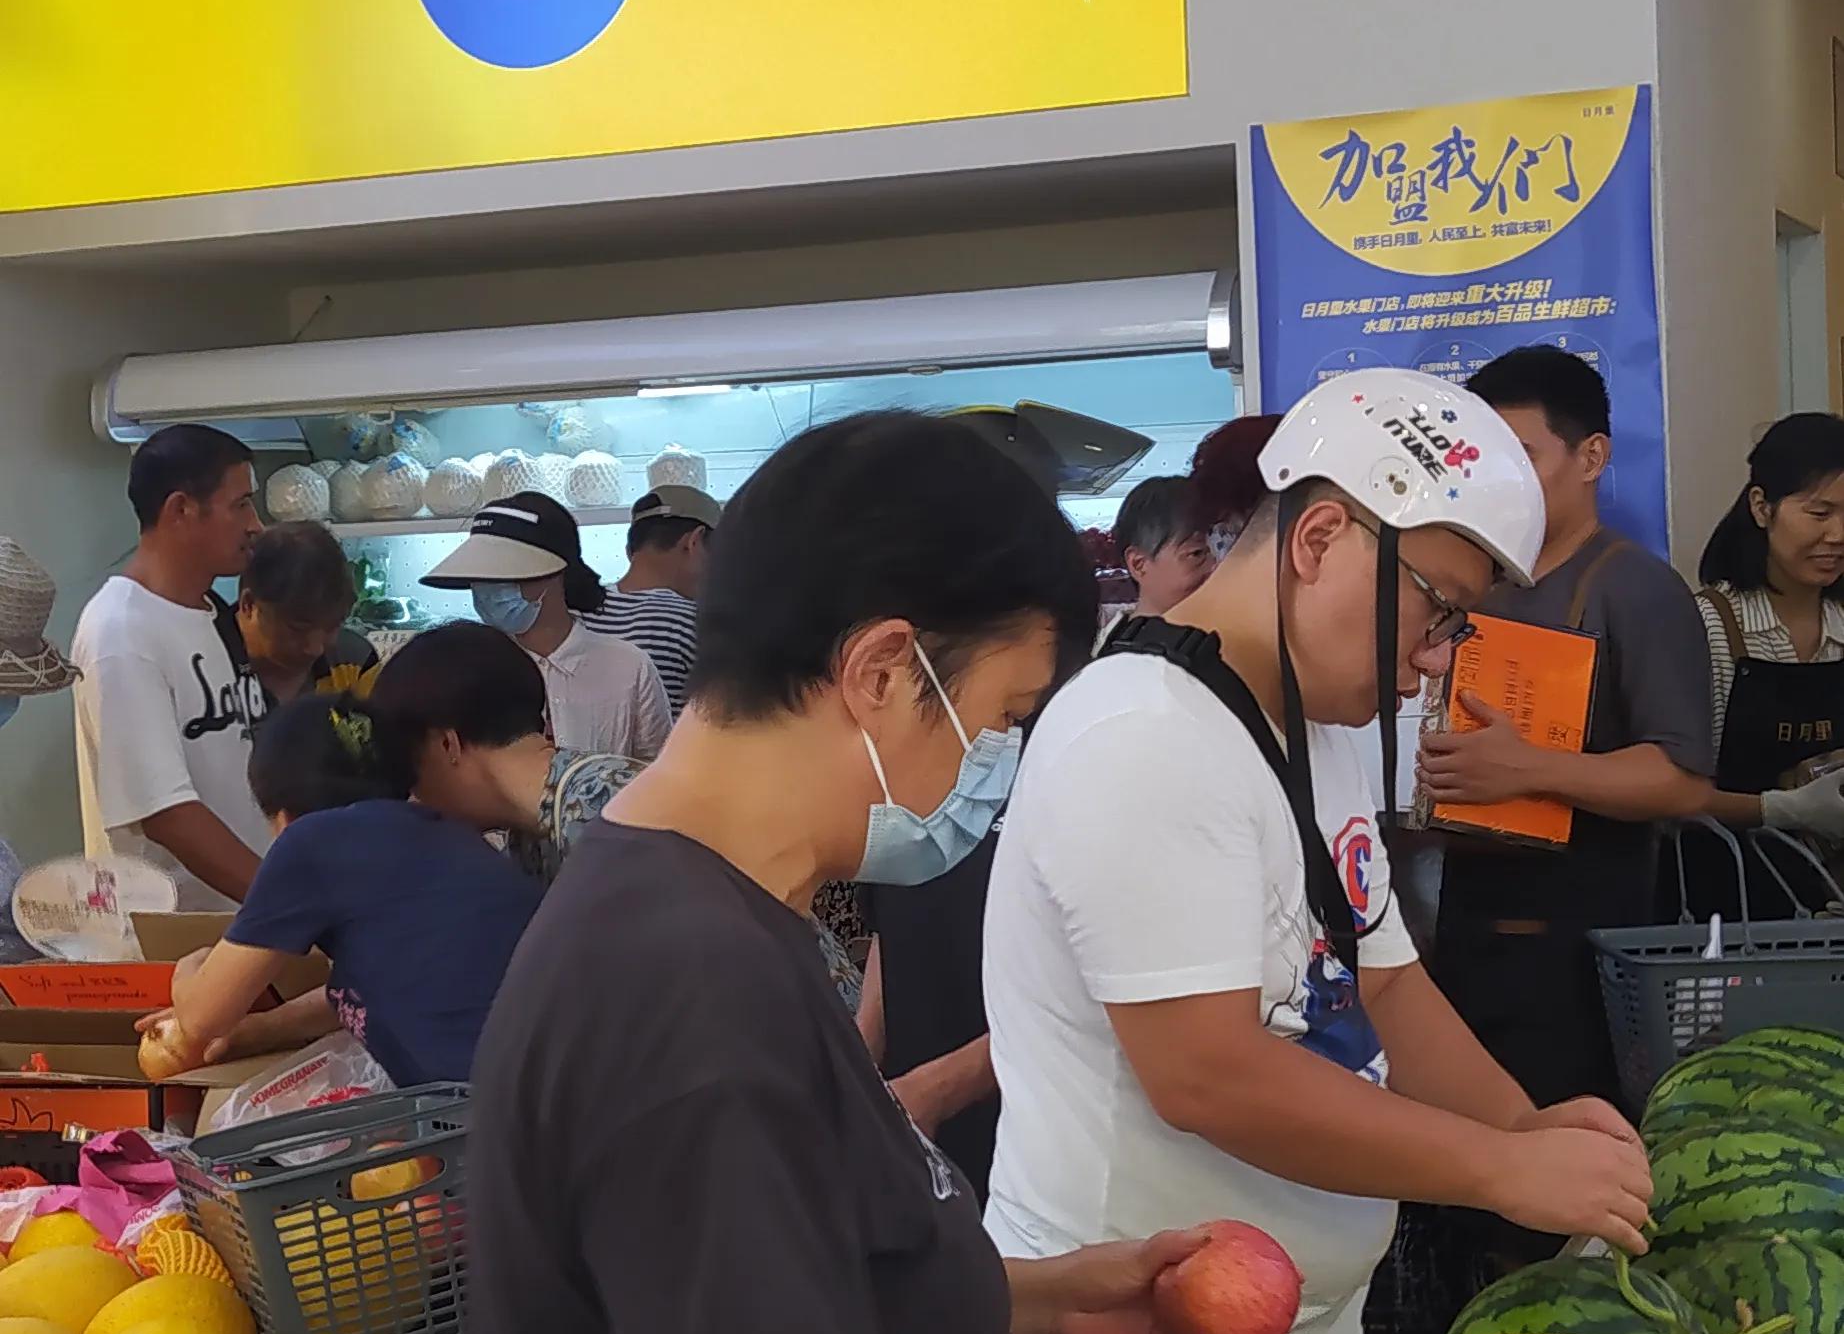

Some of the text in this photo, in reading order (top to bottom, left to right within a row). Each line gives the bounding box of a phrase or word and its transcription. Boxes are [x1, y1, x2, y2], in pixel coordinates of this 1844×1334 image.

[1319, 126, 1581, 224] 加盟我们
[1557, 336, 1568, 349] 3
[1449, 344, 1461, 357] 2
[1346, 352, 1356, 364] 1
